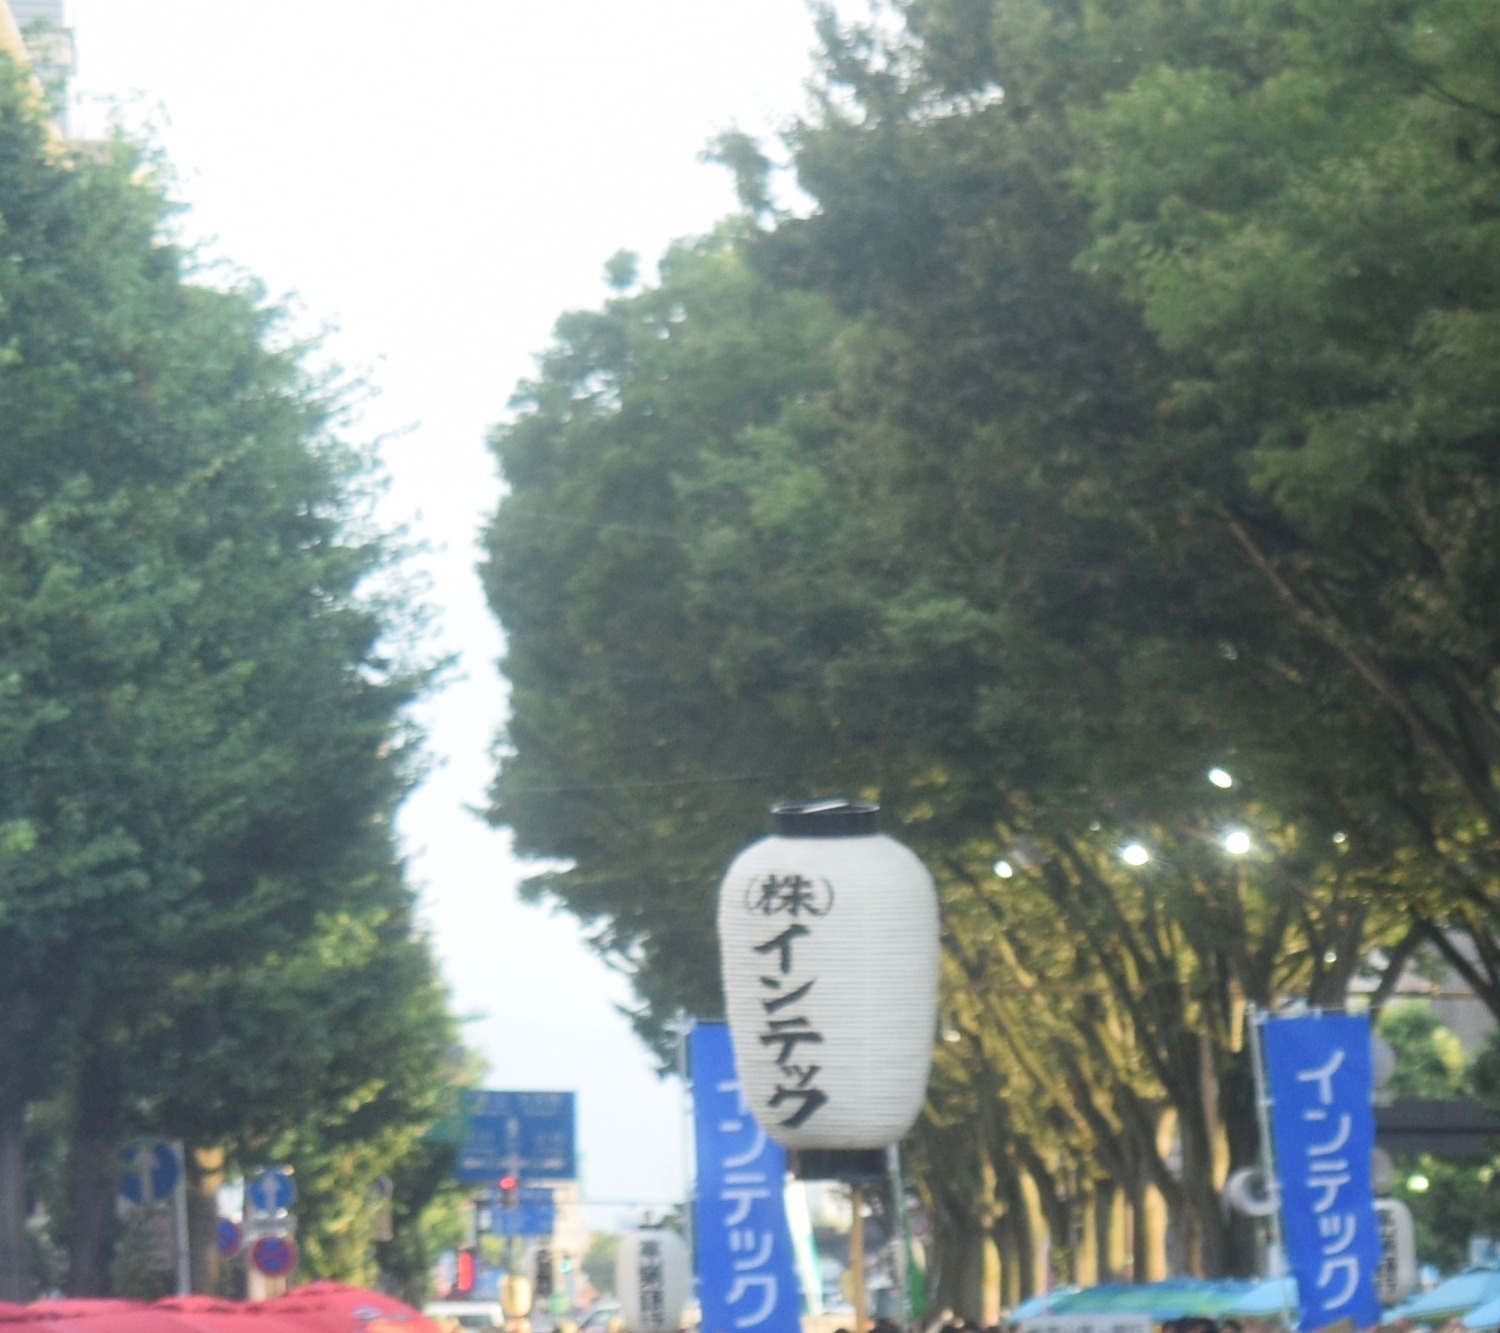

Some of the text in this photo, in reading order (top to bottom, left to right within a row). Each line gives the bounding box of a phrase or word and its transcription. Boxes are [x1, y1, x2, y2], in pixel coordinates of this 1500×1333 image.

[1297, 1050, 1362, 1311] インテック
